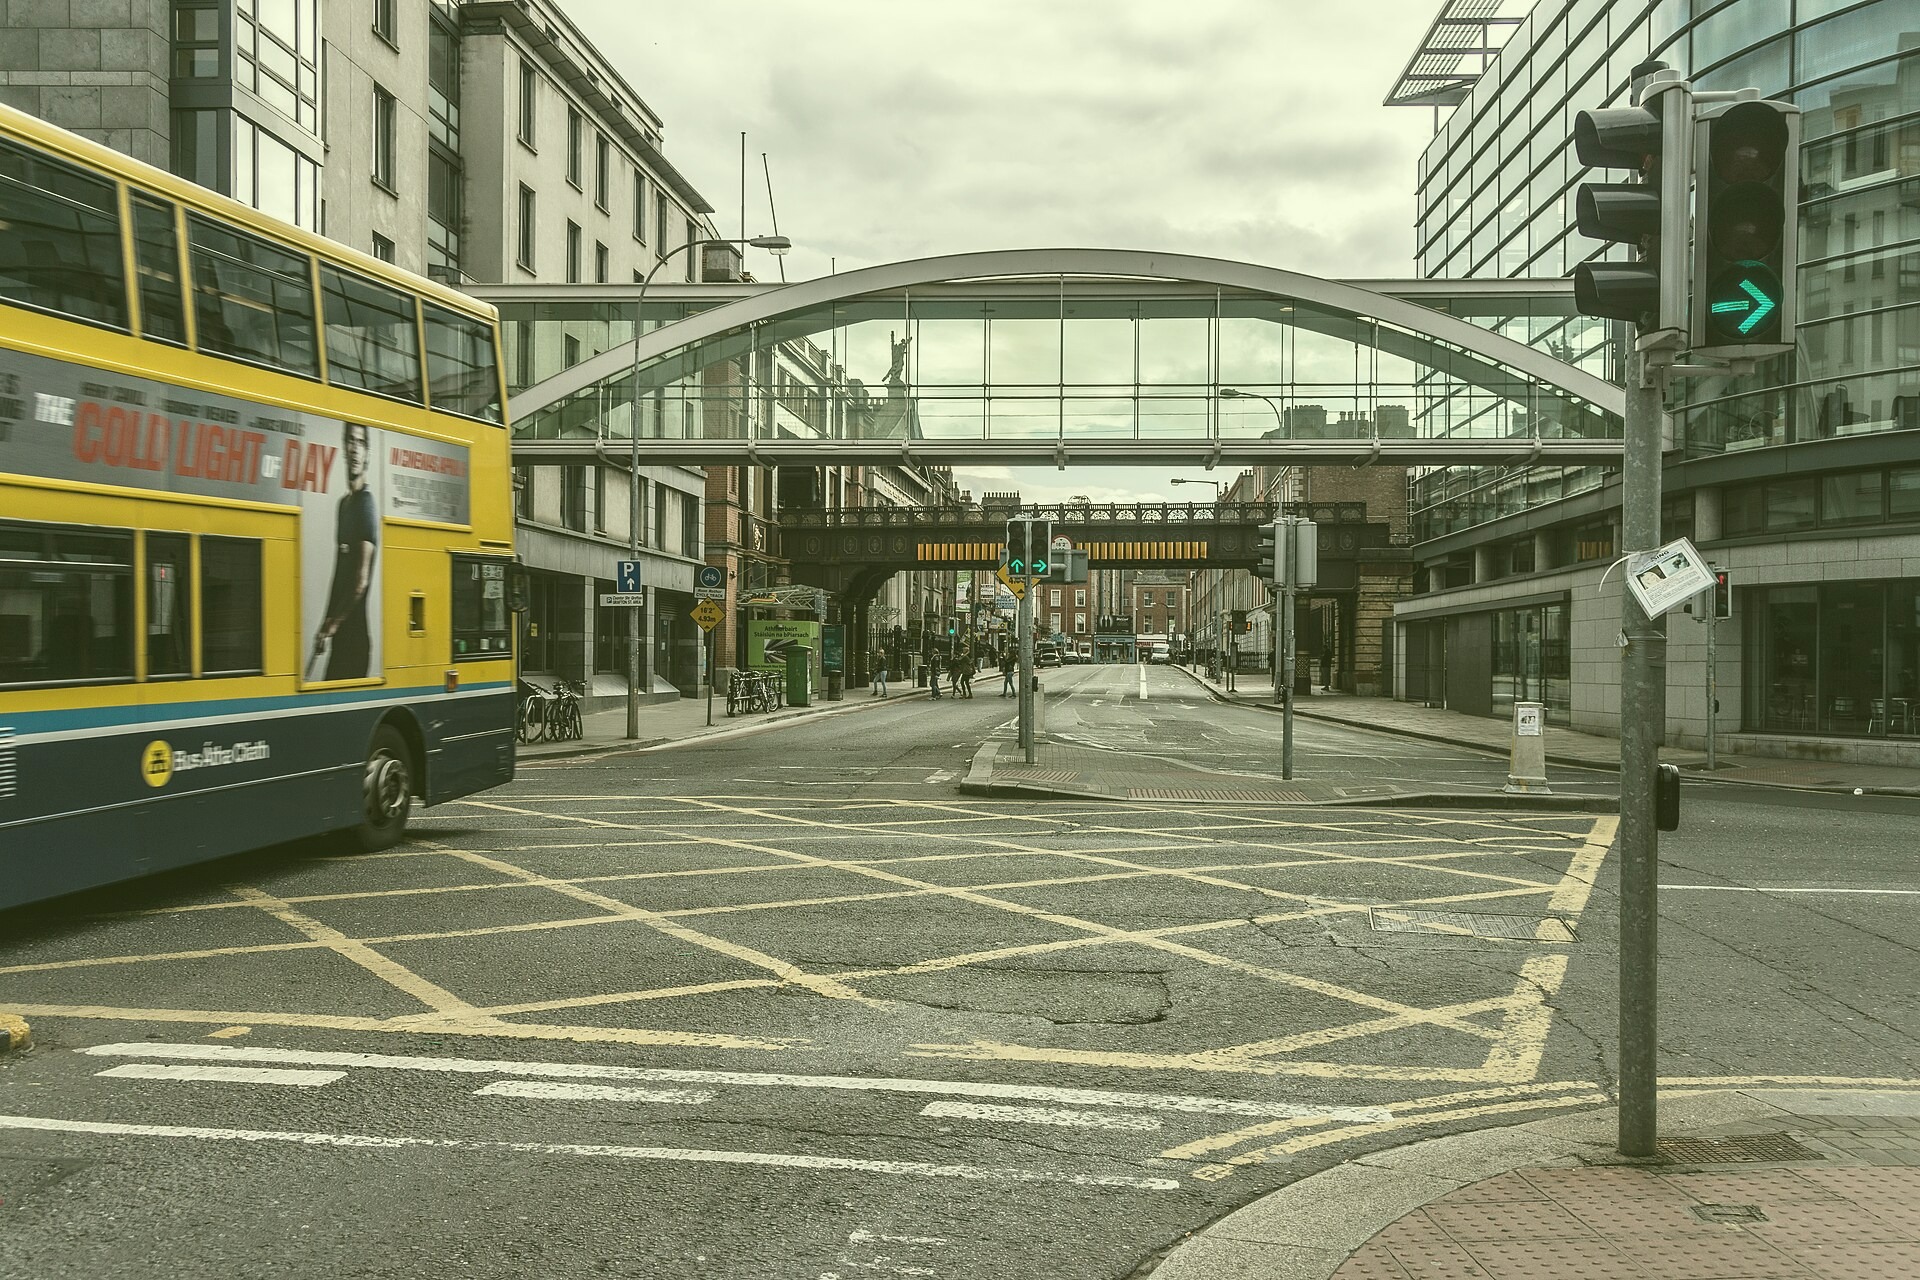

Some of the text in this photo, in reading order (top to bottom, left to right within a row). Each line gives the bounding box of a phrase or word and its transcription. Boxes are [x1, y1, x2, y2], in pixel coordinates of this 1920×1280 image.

[34, 392, 76, 426] THE
[73, 401, 171, 472] COLD
[175, 420, 267, 485] LIGHT
[261, 454, 282, 479] OF
[281, 437, 338, 494] DAY
[624, 562, 634, 578] P
[172, 750, 202, 772] Bus
[232, 740, 270, 763] Cliath
